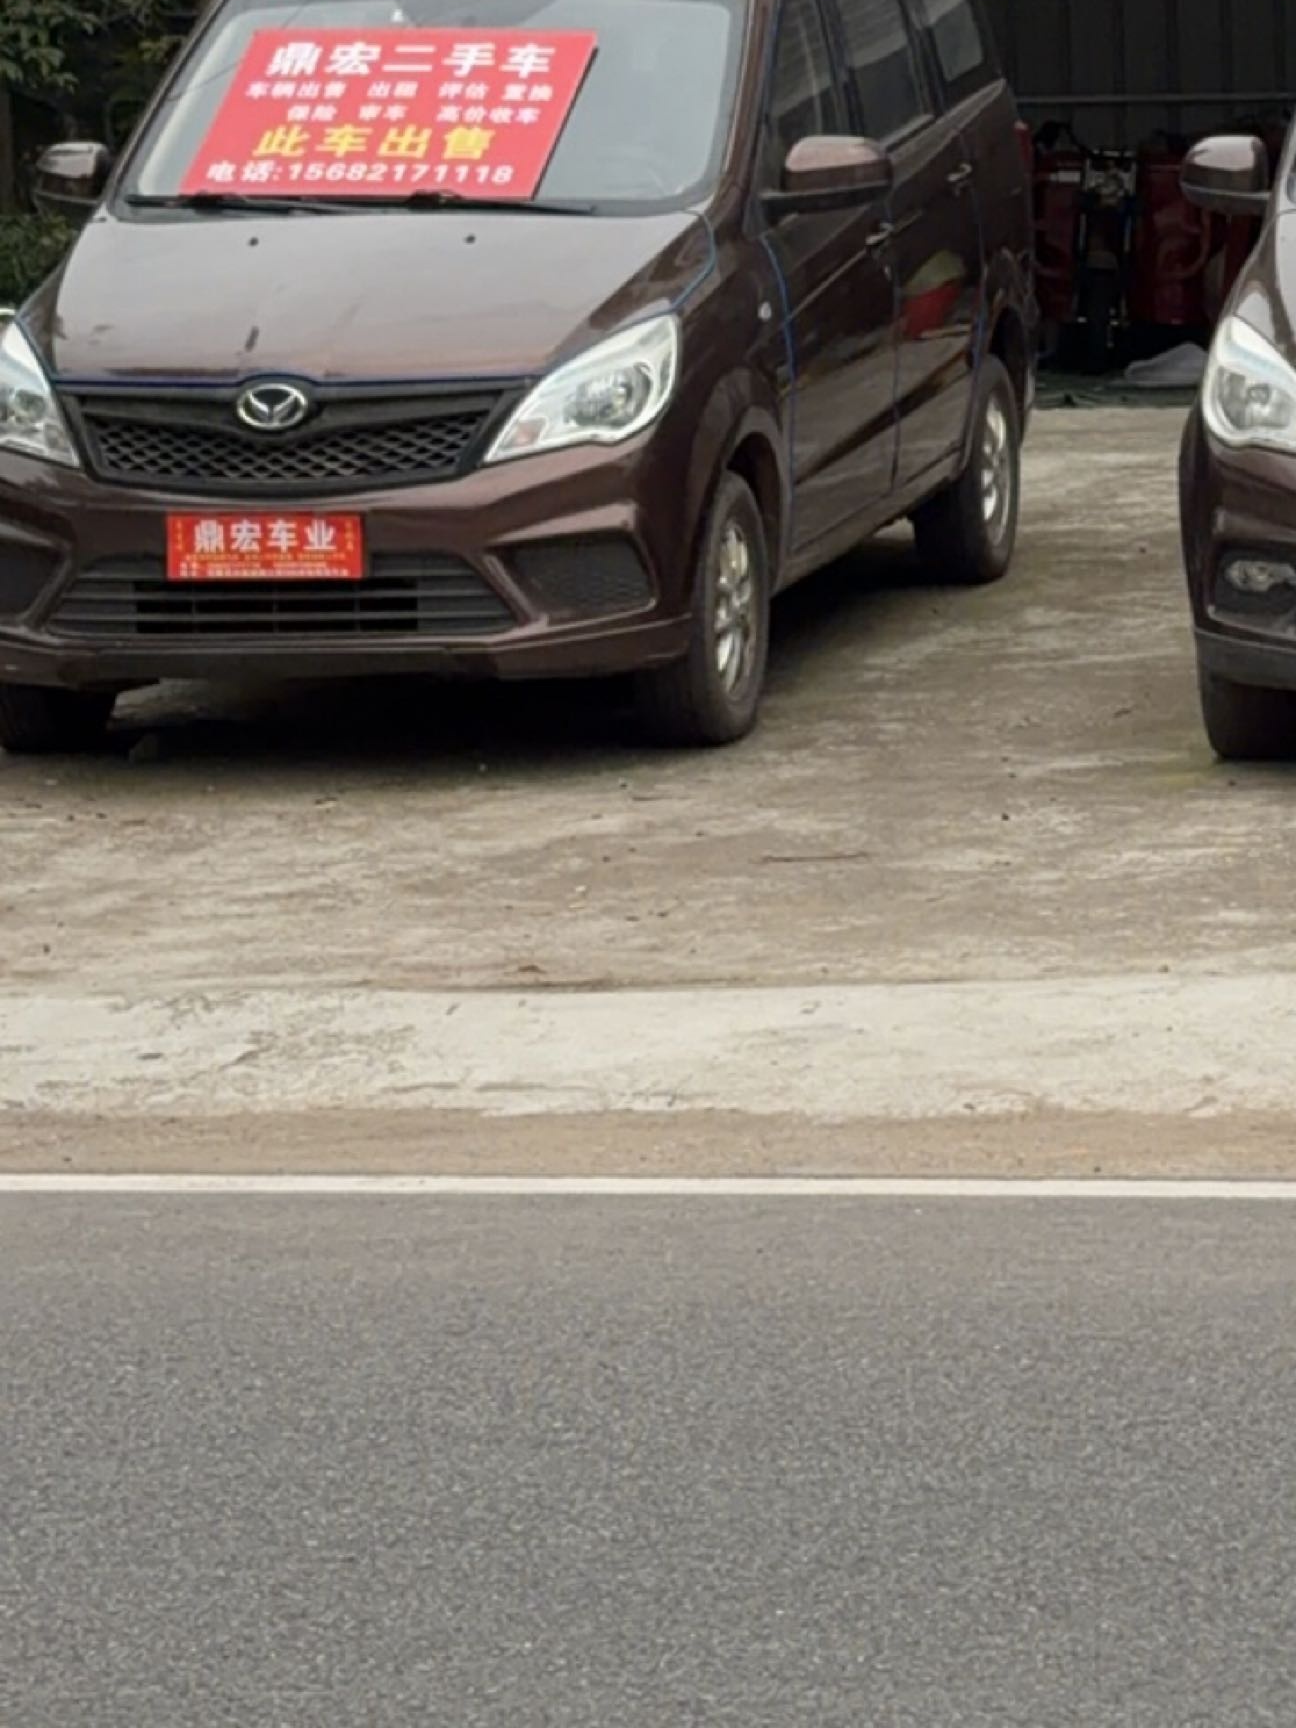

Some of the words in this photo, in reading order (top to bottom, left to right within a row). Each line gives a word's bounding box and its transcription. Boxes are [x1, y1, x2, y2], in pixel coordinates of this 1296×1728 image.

[266, 41, 555, 79] 鼎宏二手车
[252, 124, 495, 160] 此车出售
[194, 519, 336, 553] 鼎宏车业
